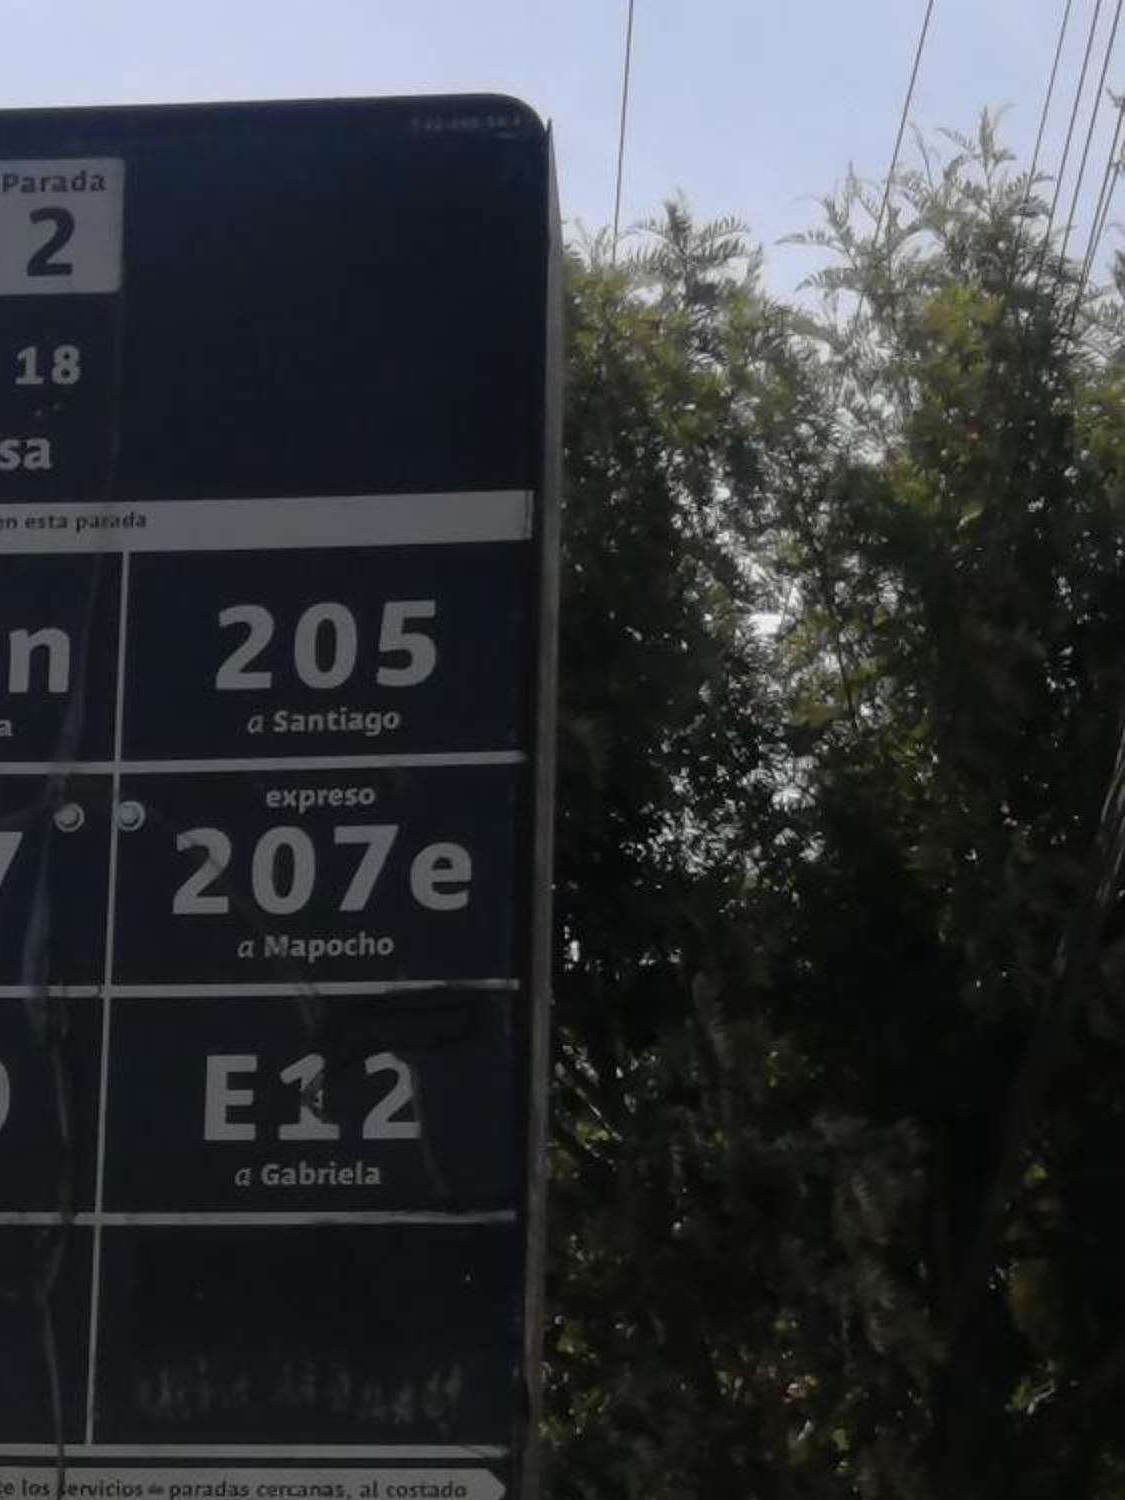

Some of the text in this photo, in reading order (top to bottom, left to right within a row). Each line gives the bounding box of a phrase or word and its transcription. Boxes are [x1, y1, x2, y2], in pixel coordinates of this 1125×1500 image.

[2, 170, 106, 195] Parada
[27, 207, 74, 277] 2
[16, 345, 81, 386] 18
[25, 514, 68, 530] esta
[76, 511, 146, 534] parada
[216, 600, 437, 690] 205
[247, 707, 401, 736] a Santiago
[266, 786, 376, 814] expreso
[173, 825, 472, 914] 207e
[238, 932, 395, 962] a Mapocho
[204, 1052, 422, 1141] E12
[235, 1161, 382, 1187] a Gabriela
[22, 1478, 50, 1498] los
[58, 1479, 143, 1498] servicios
[169, 1482, 250, 1500] paradas
[256, 1484, 352, 1500] cercanas,
[359, 1482, 378, 1498] al
[386, 1482, 467, 1499] costado
